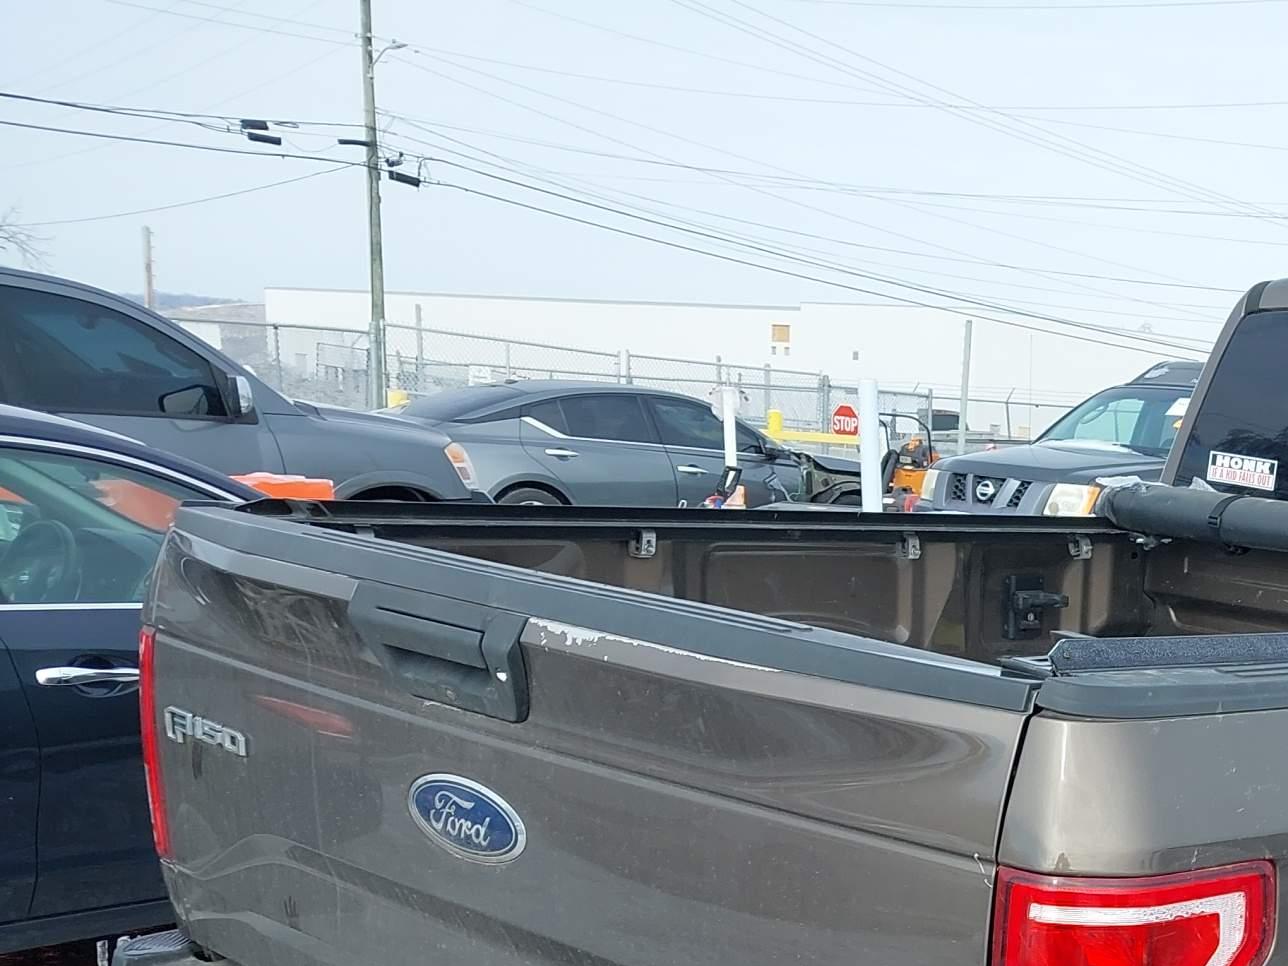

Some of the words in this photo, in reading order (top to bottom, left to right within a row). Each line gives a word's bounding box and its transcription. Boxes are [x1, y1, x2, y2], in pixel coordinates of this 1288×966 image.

[833, 415, 858, 433] STOP
[1215, 454, 1272, 474] HONK
[1257, 474, 1271, 487] OUT
[430, 790, 492, 847] Ford
